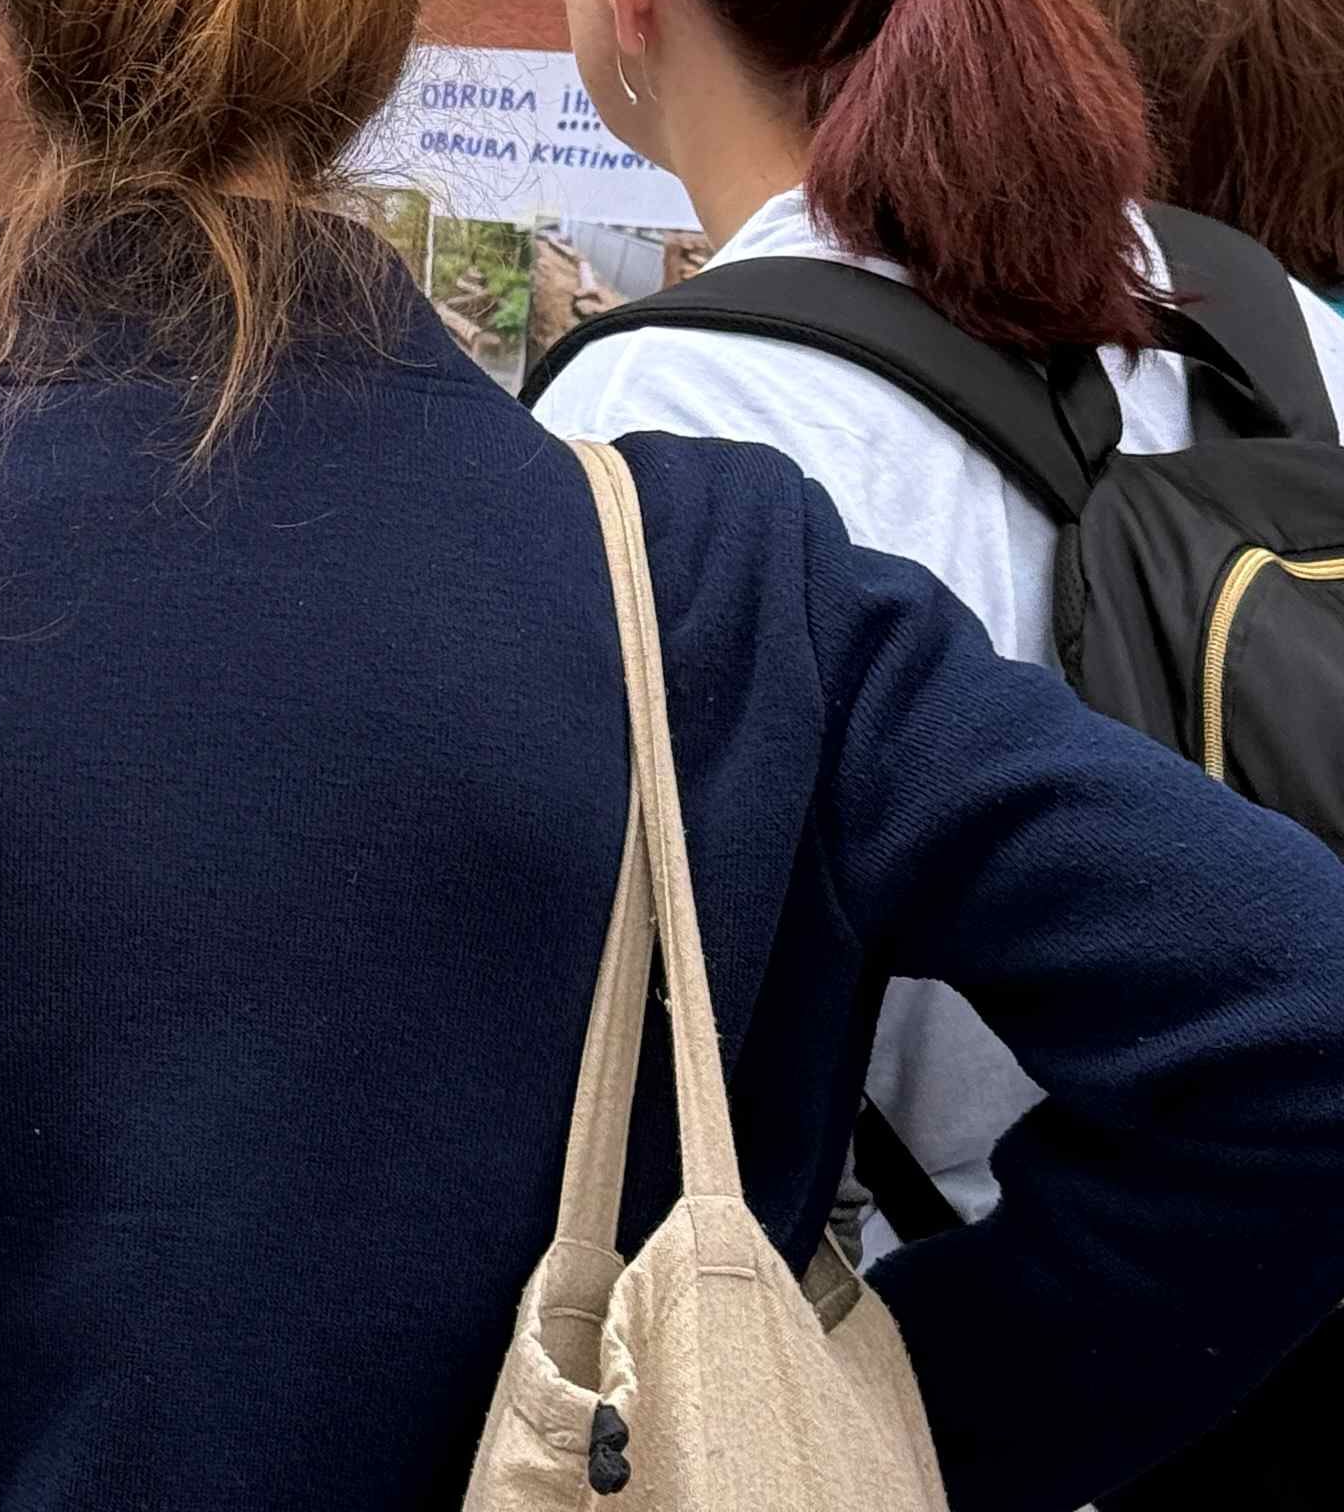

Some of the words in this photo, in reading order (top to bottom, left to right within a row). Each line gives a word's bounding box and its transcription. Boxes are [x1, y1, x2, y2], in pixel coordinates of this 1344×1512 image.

[421, 80, 537, 112] OBRUBA
[560, 84, 597, 118] IH
[419, 132, 517, 161] OBRUBA
[530, 142, 657, 170] KVETINOV
